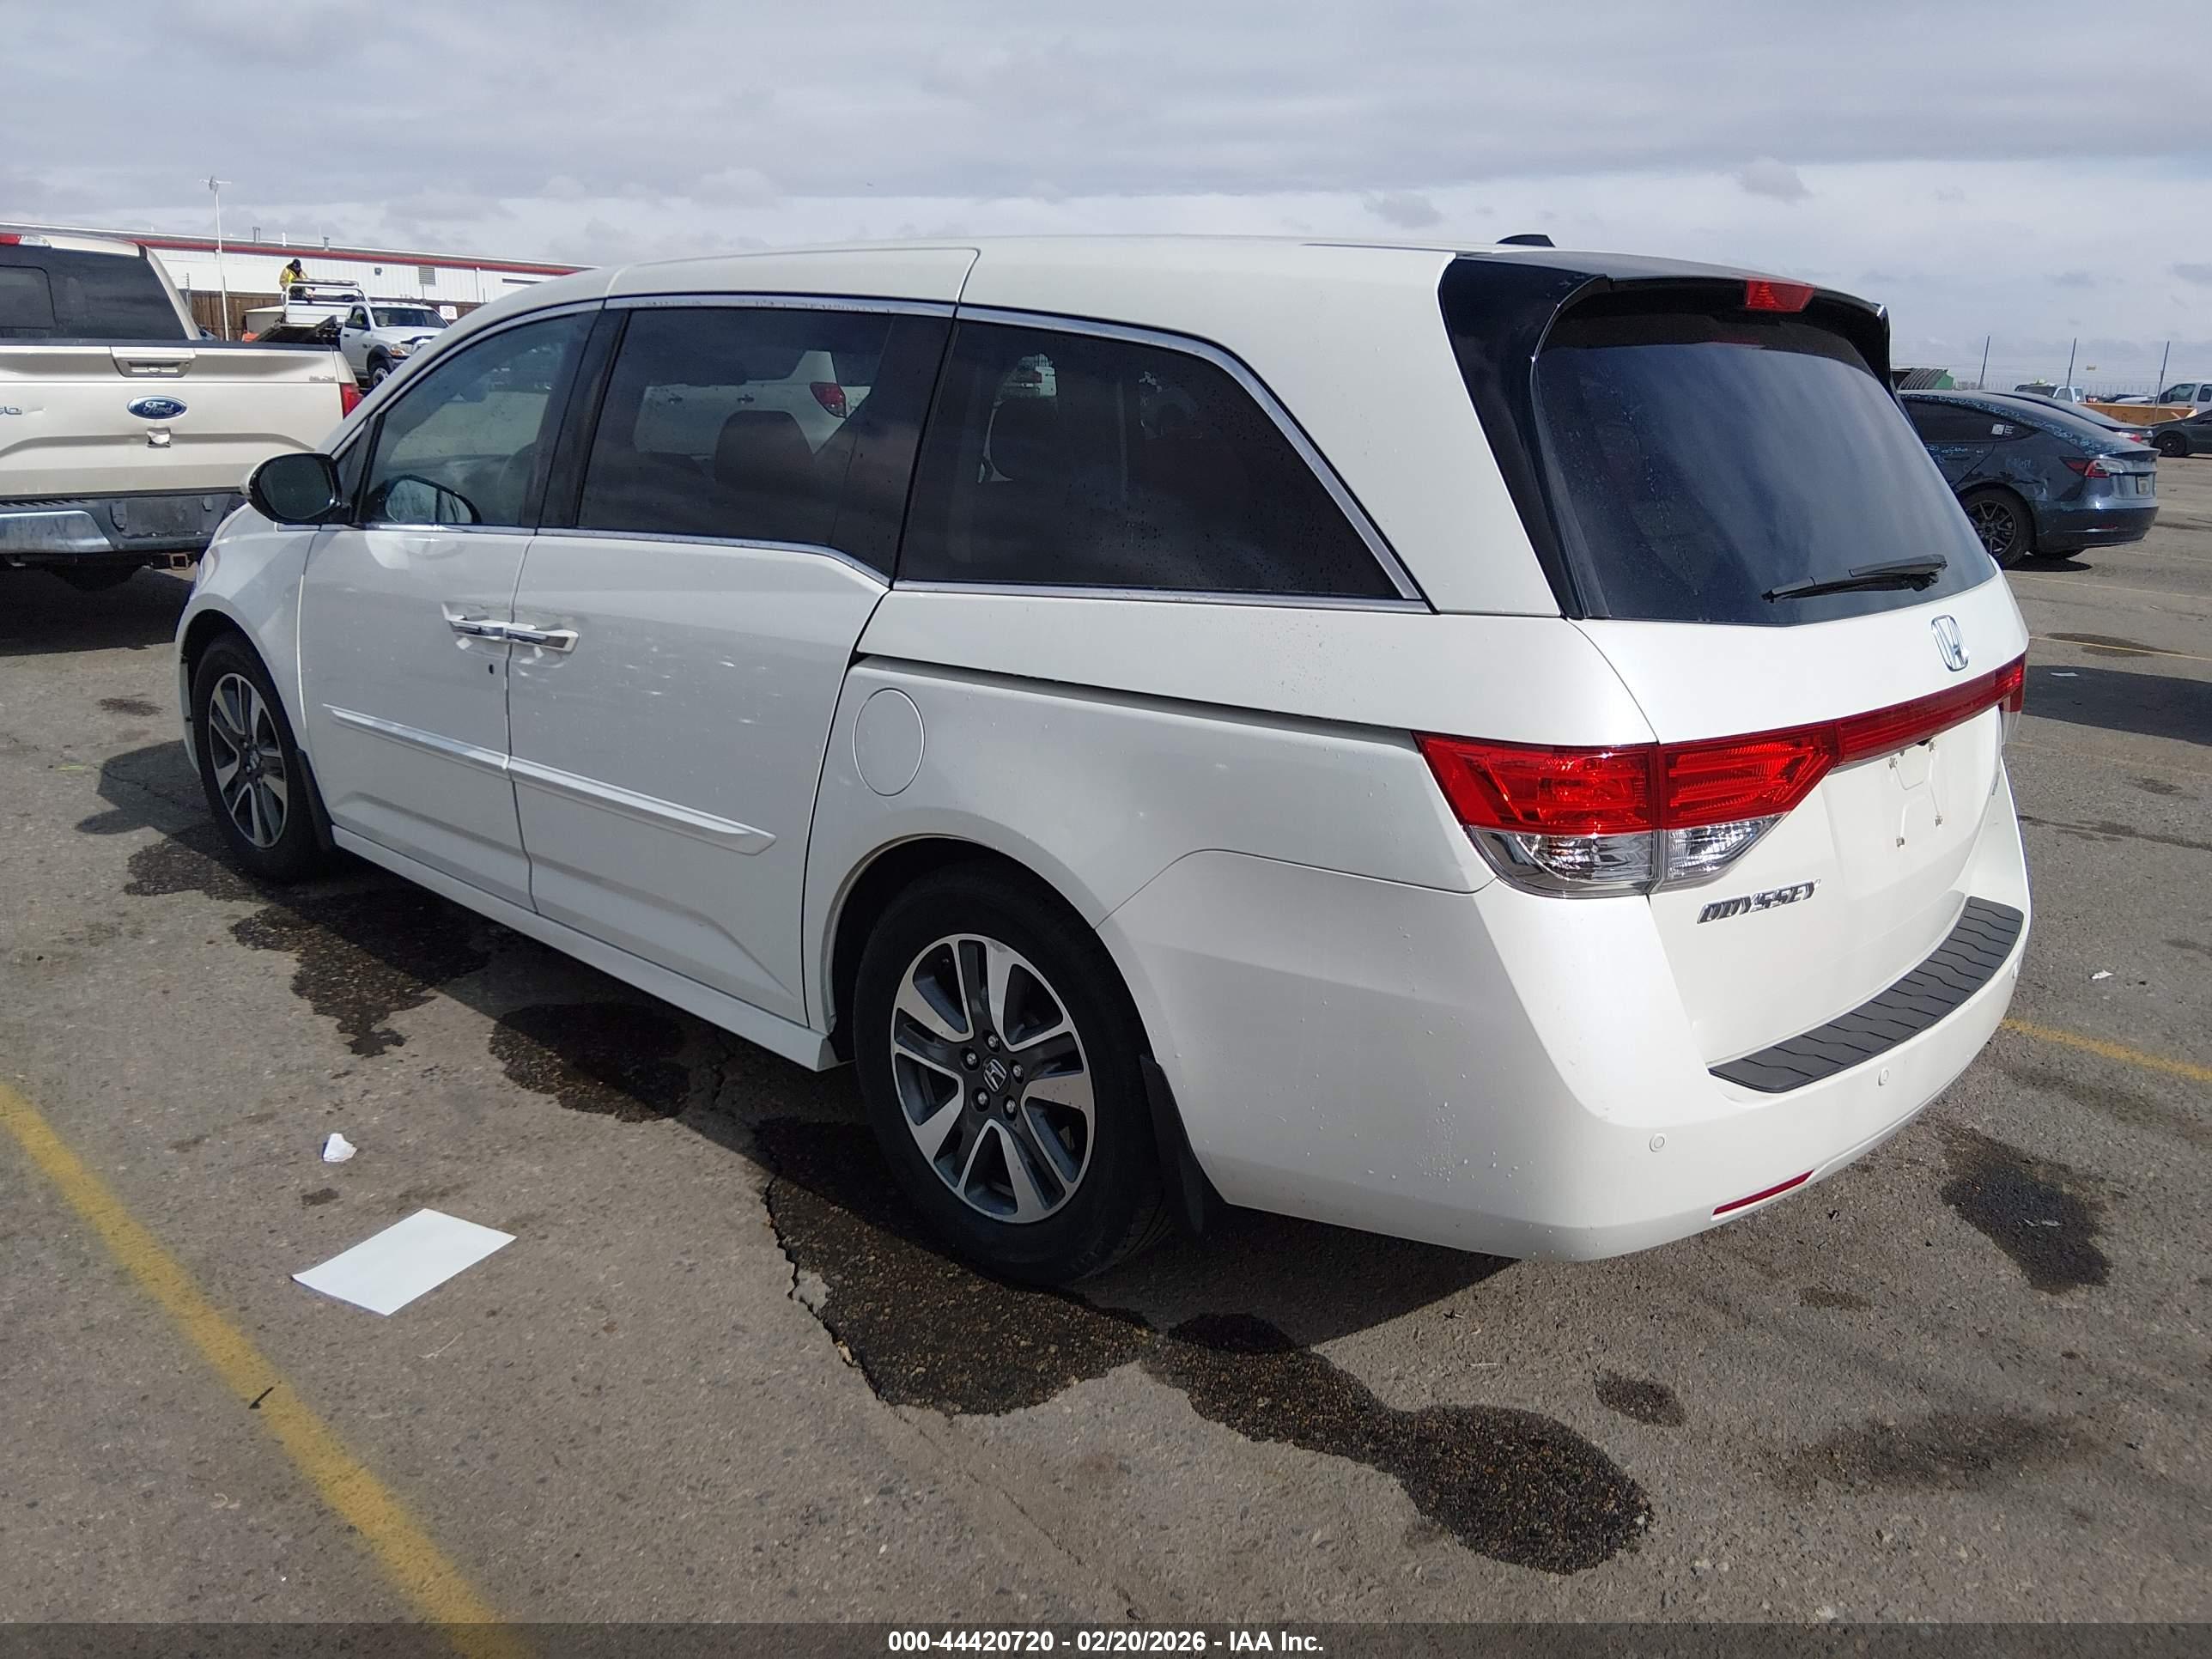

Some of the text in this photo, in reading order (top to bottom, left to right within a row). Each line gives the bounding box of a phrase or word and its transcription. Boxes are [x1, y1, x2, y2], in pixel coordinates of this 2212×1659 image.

[442, 307, 454, 317] 36
[142, 400, 174, 415] Ford
[1697, 879, 1820, 925] ODYSSEY
